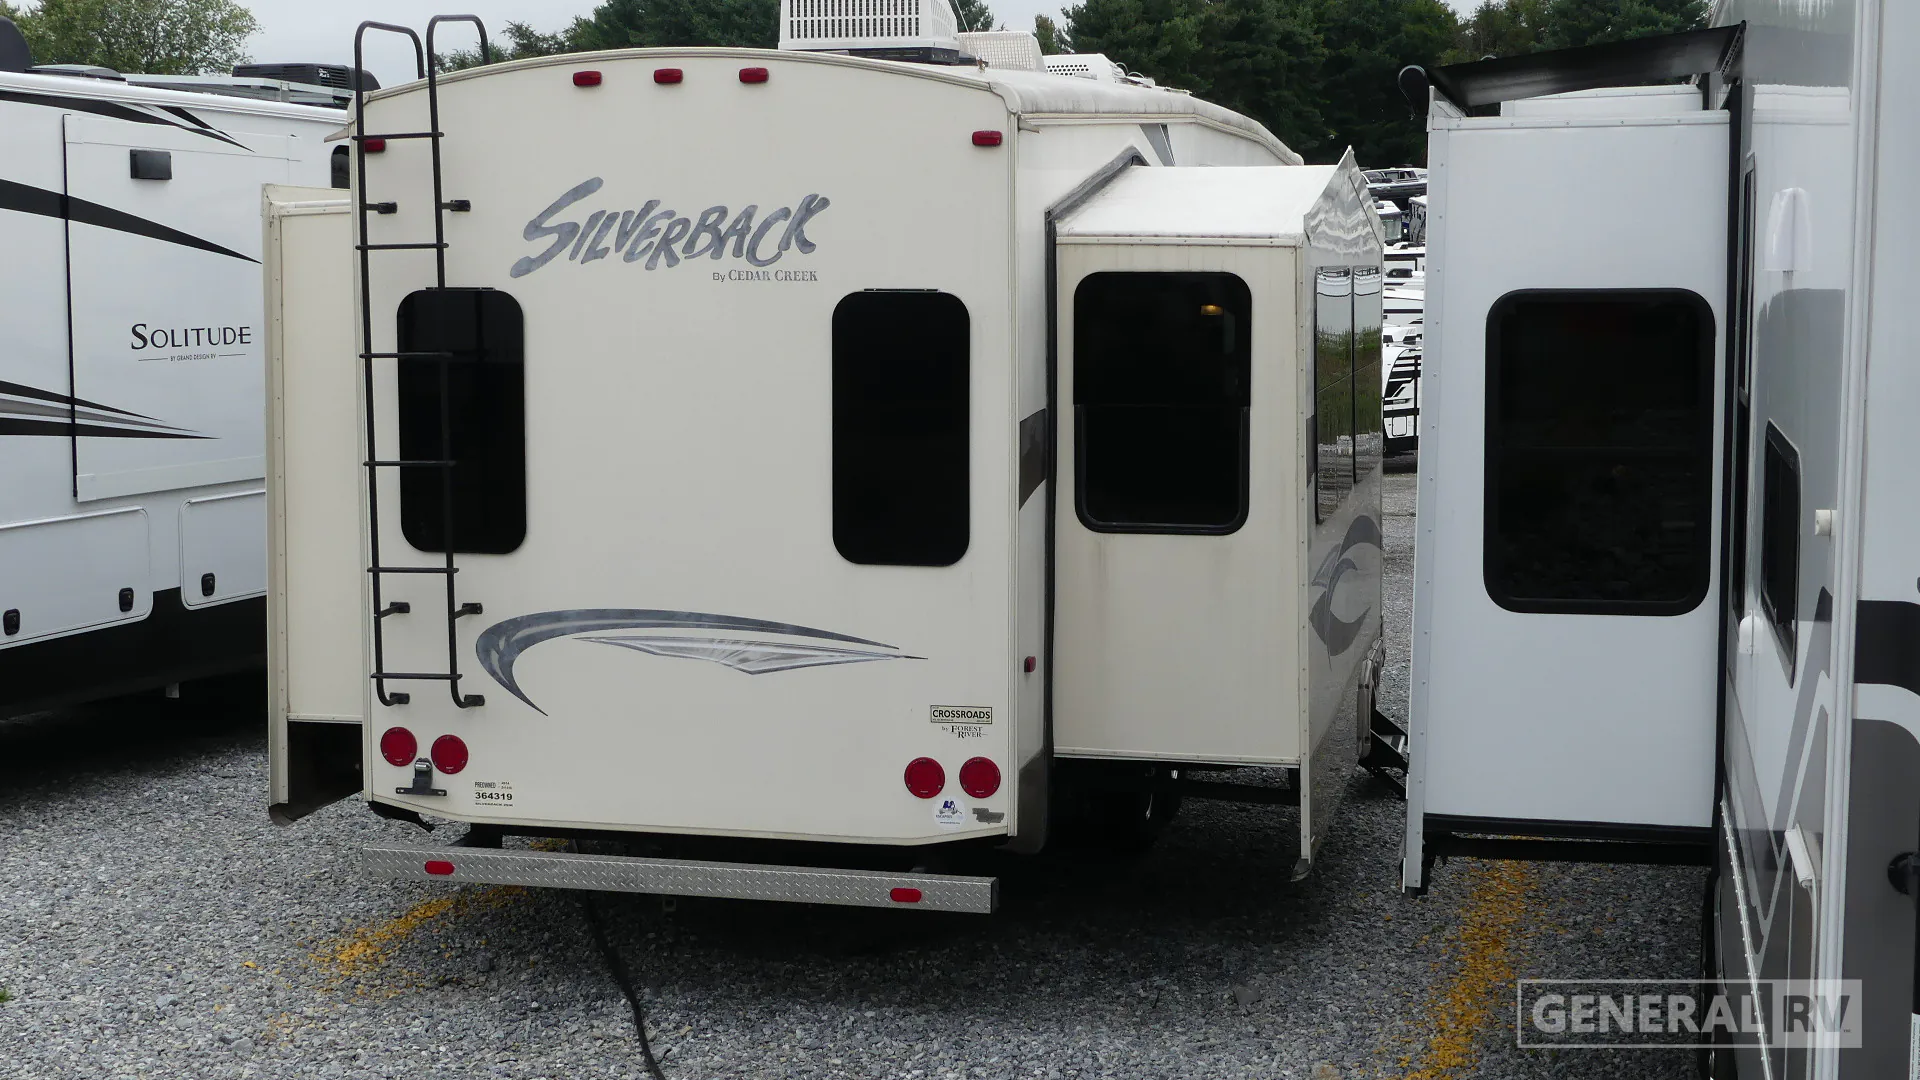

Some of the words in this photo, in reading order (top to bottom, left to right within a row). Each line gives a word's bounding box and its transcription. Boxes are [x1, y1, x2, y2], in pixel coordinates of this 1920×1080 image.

[509, 176, 831, 279] SILVERBACK
[712, 272, 726, 282] By
[728, 269, 771, 281] CEDAR
[774, 269, 818, 282] CREEK
[131, 323, 251, 350] SOLITUDE
[932, 709, 991, 719] CROSSROADS
[475, 791, 512, 800] 364319
